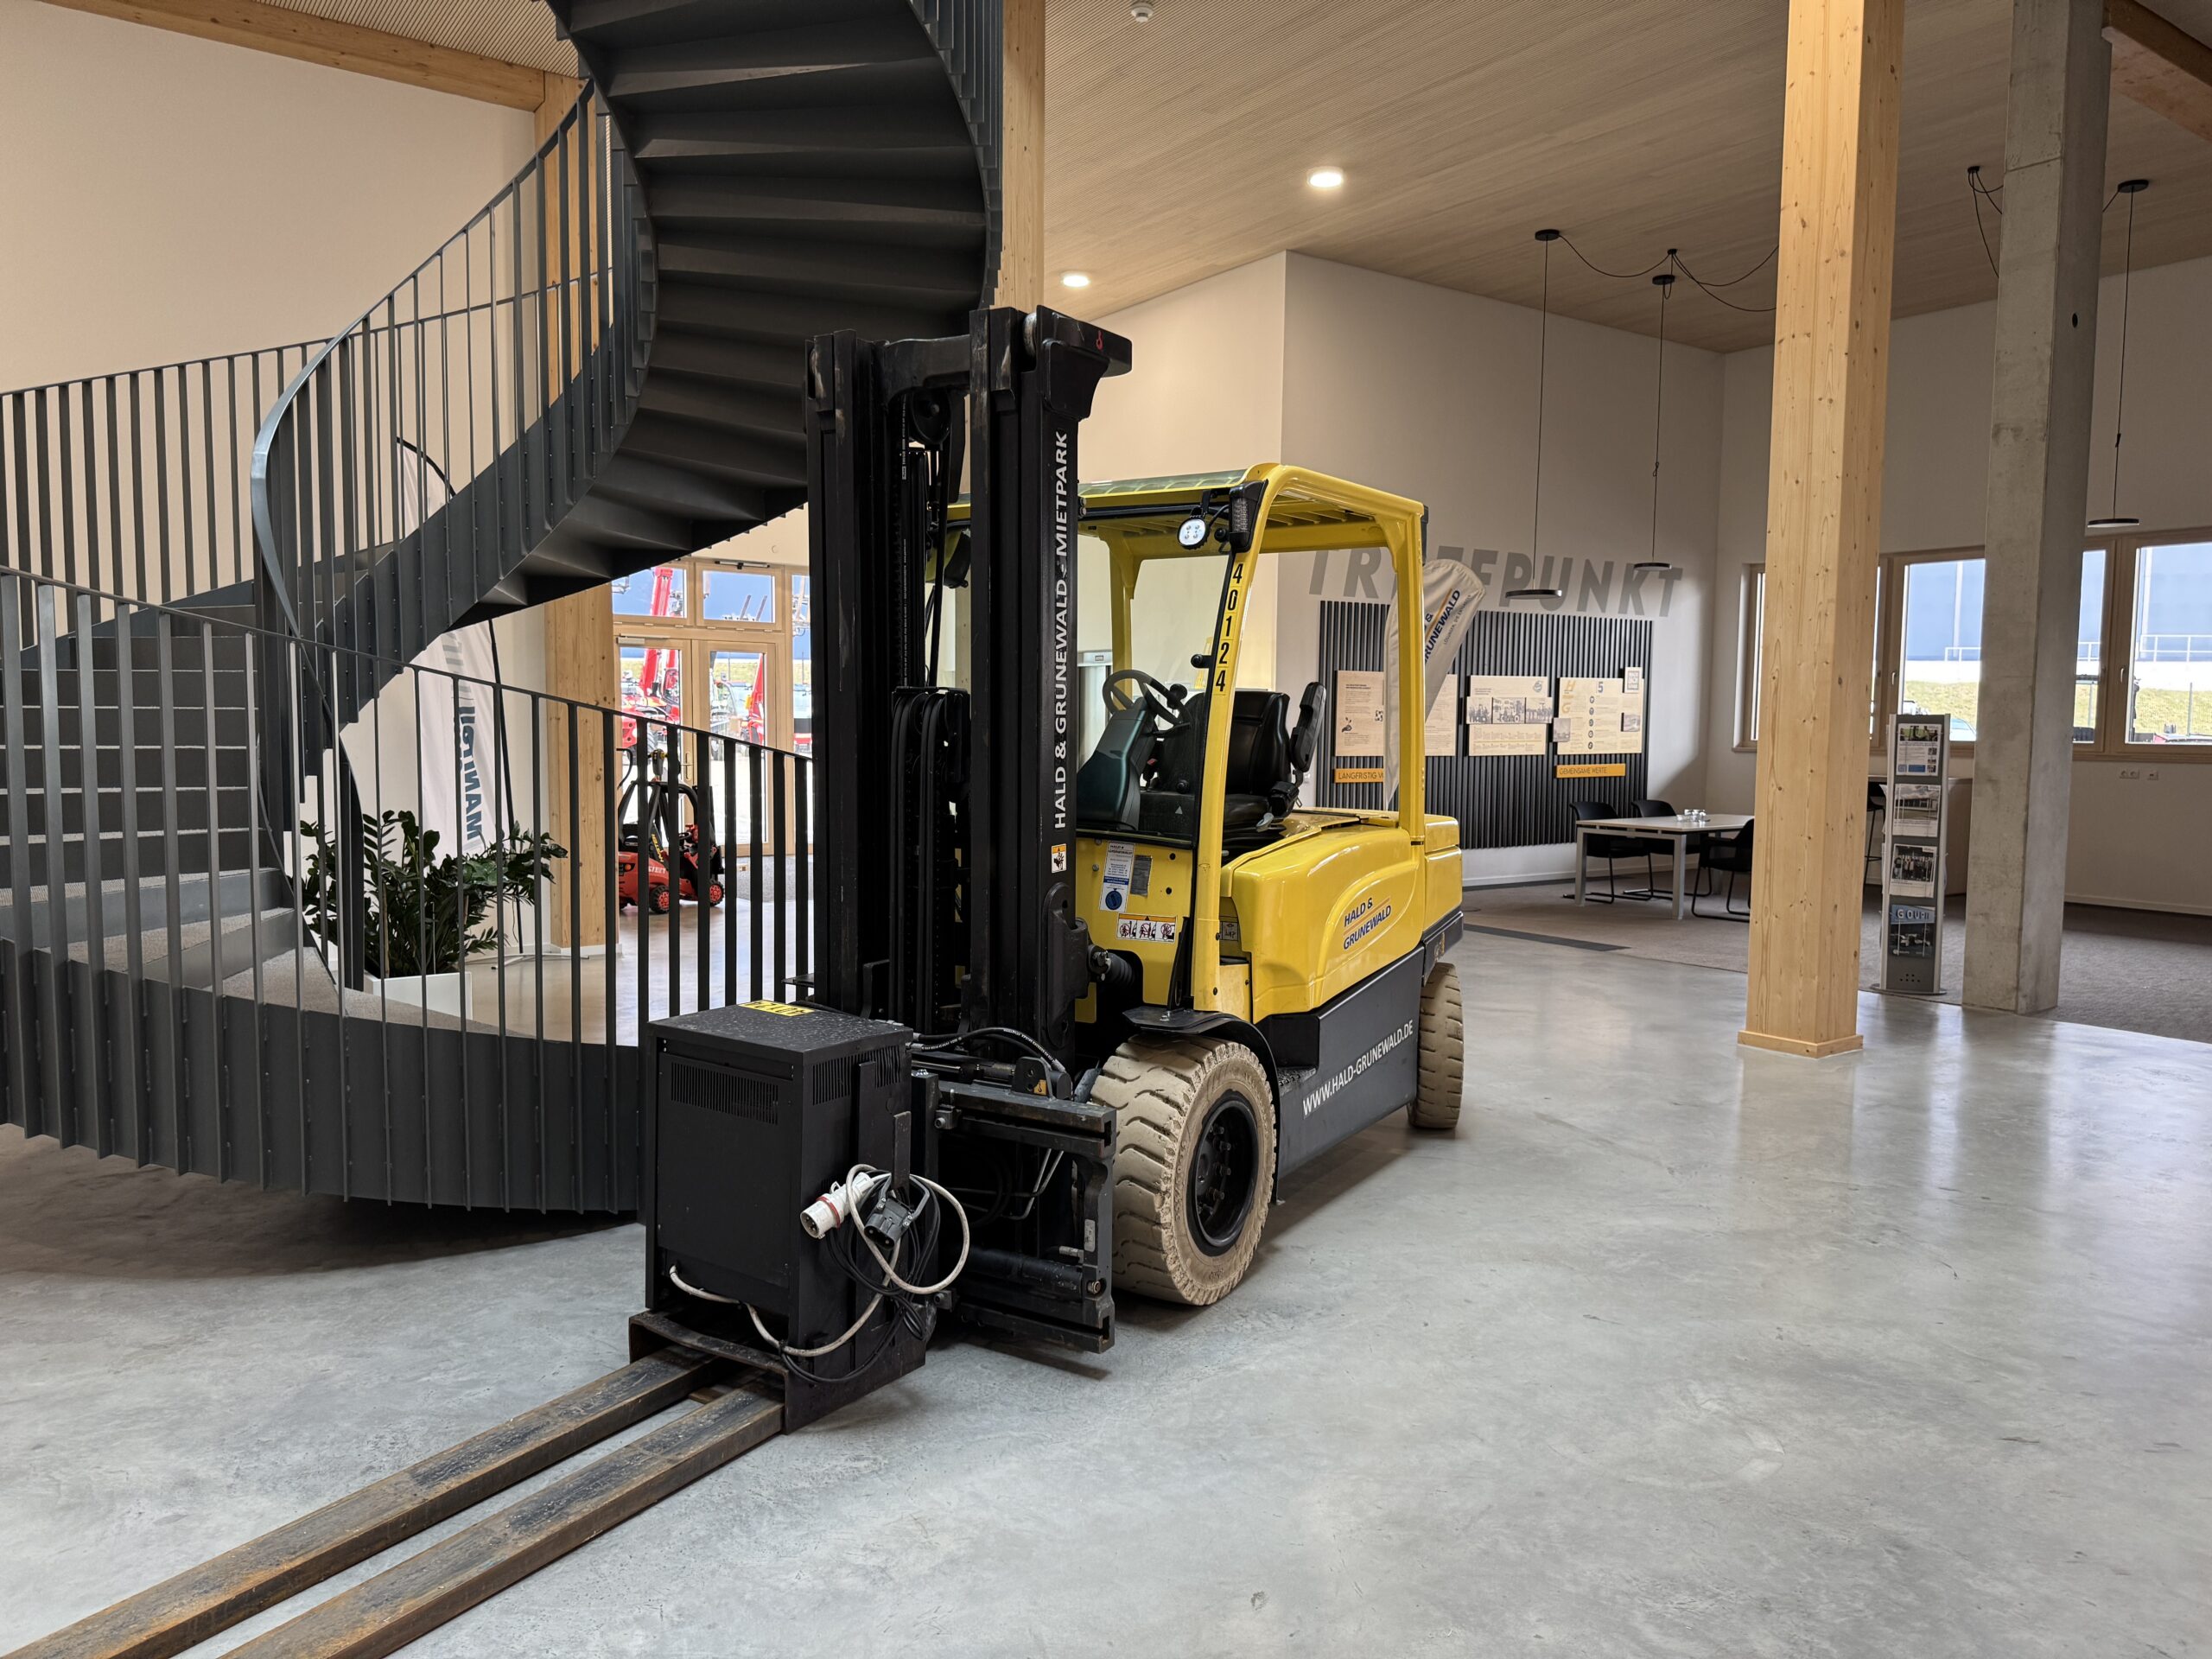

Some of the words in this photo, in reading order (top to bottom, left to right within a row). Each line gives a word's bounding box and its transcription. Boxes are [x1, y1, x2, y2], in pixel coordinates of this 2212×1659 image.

[1055, 431, 1068, 557] MIETPARK
[1309, 546, 1683, 617] TRFPUNKT
[1055, 579, 1067, 734] GRUNEWALD
[1215, 563, 1243, 692] 40124
[1424, 589, 1460, 664] RUNEWALD
[1598, 681, 1604, 693] 5
[1055, 741, 1067, 760] &
[1338, 772, 1377, 780] LANGFRISTIG
[1055, 766, 1067, 830] HALD
[1344, 902, 1366, 927] HALD
[1367, 897, 1373, 910] &
[1344, 905, 1392, 950] GRUNEWALD
[1302, 1020, 1414, 1116] WWW.HALD-GRUNEWALD.DE
